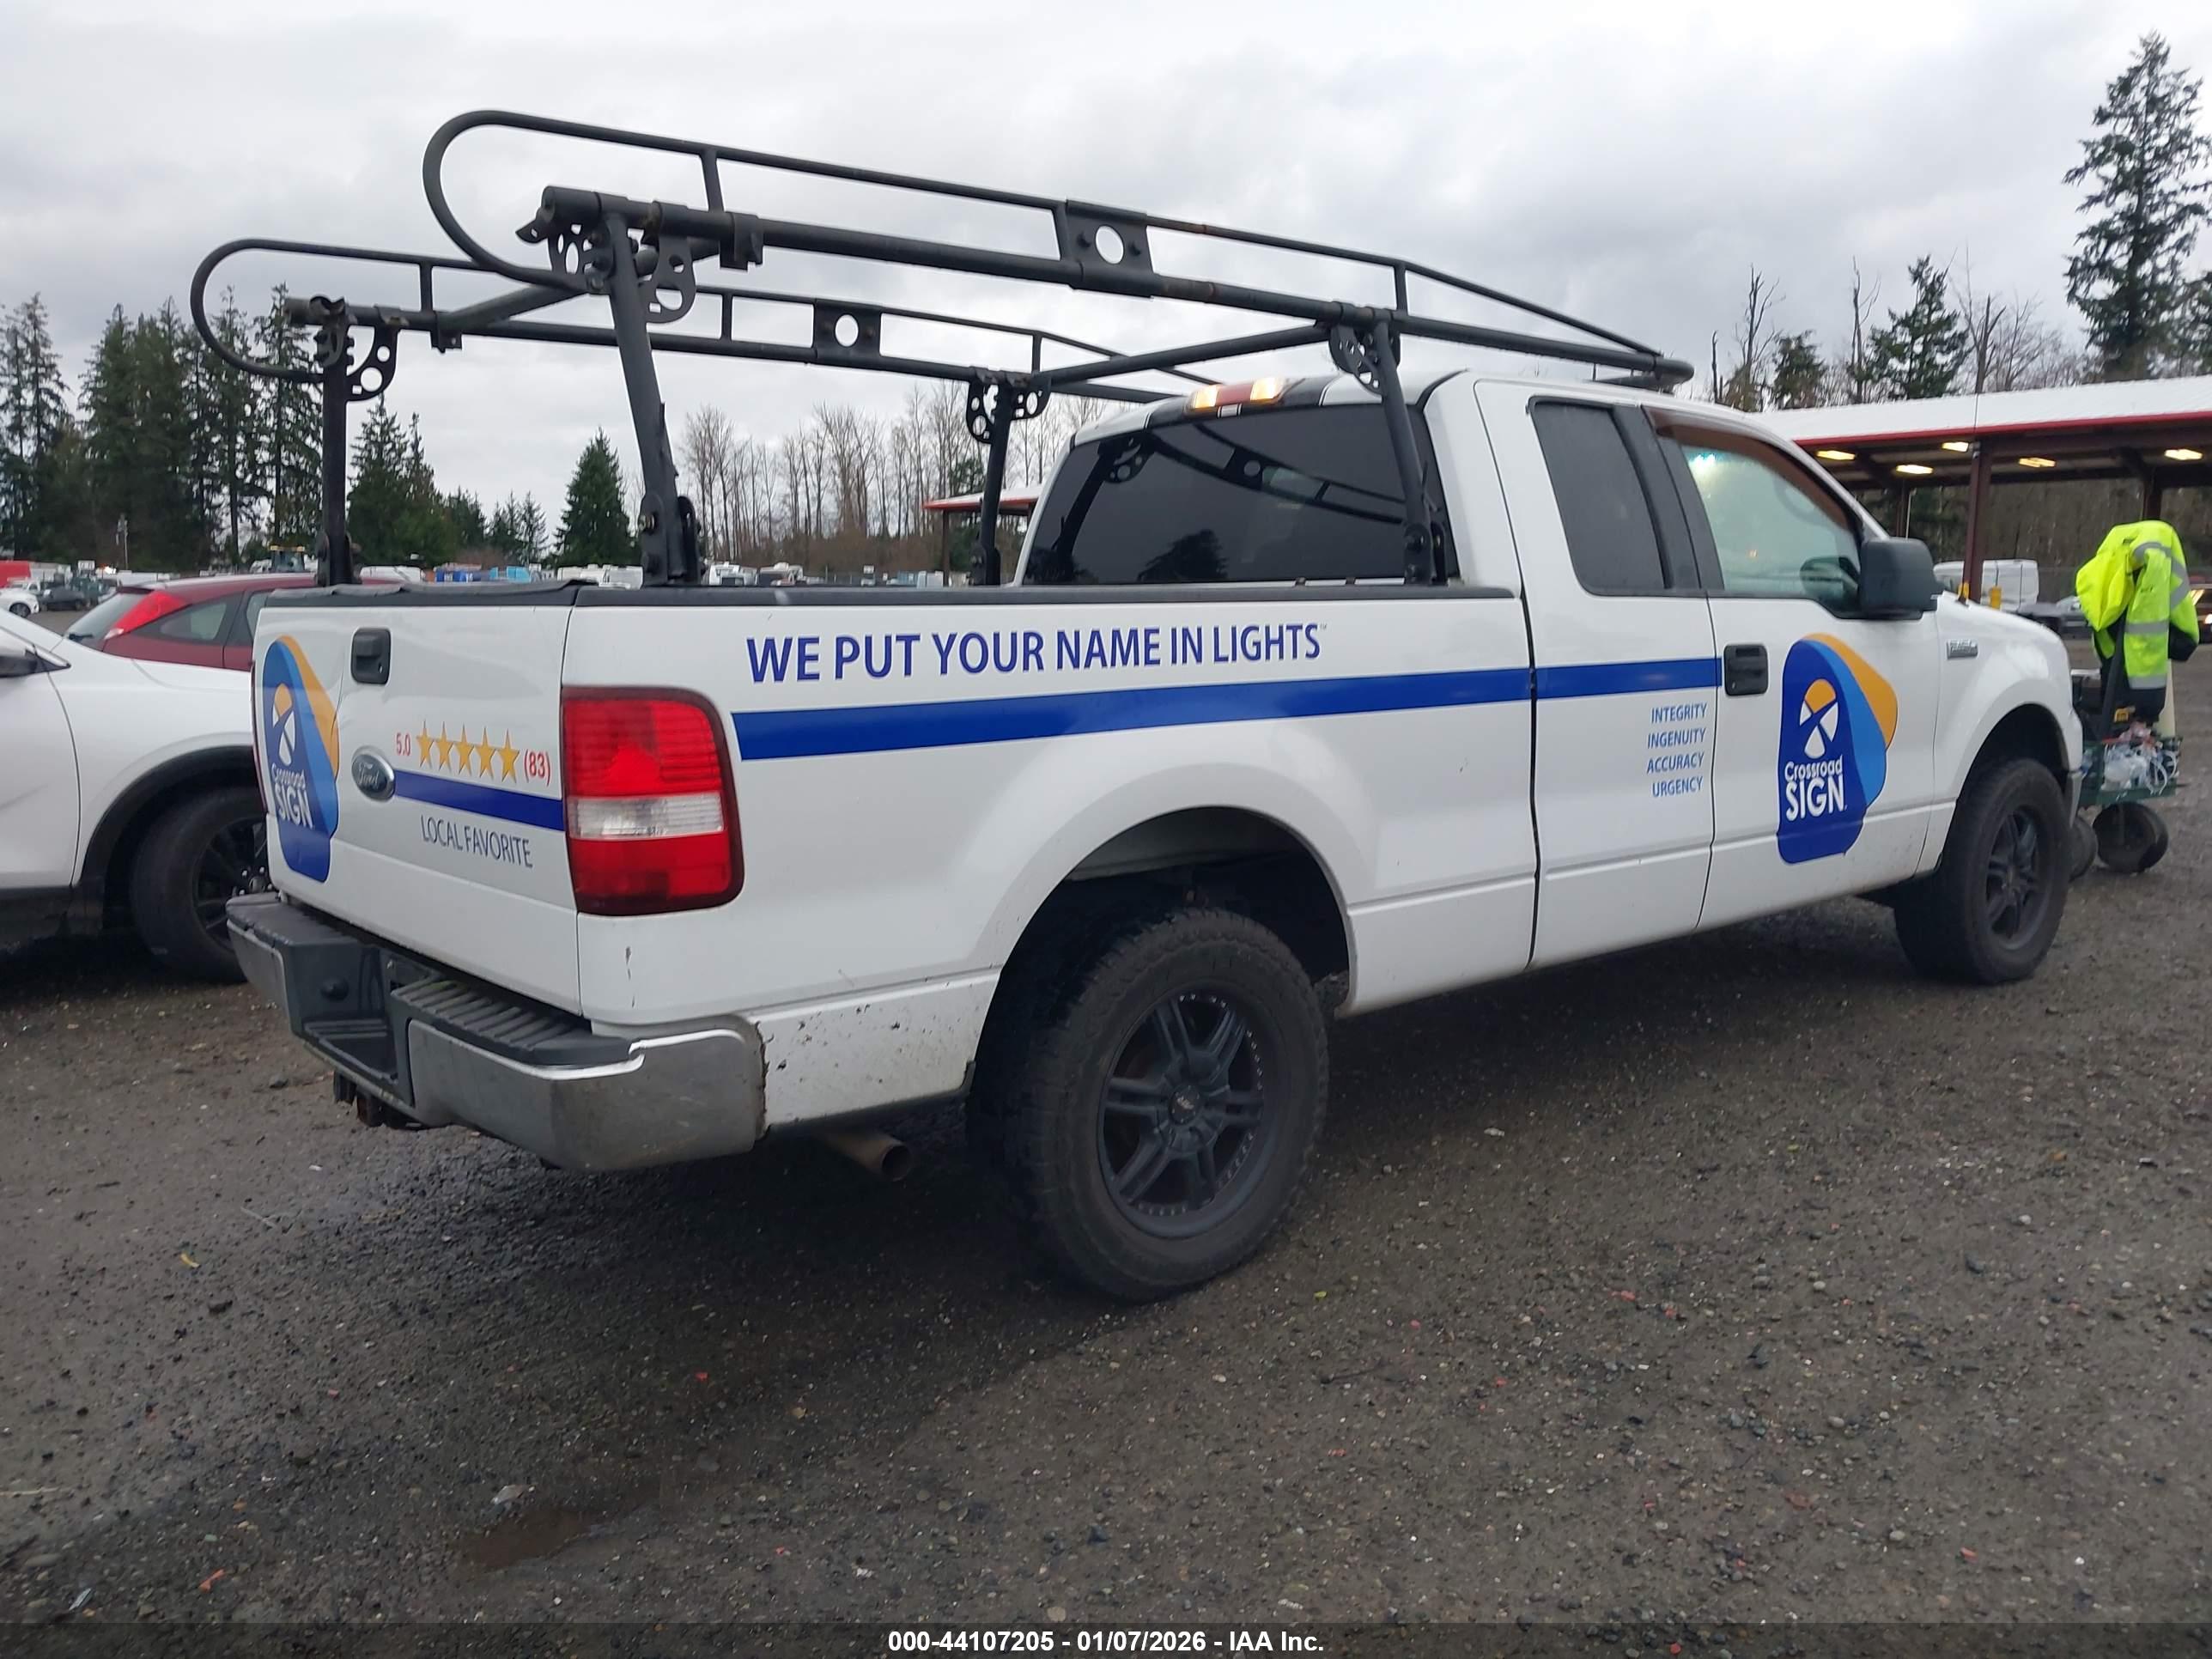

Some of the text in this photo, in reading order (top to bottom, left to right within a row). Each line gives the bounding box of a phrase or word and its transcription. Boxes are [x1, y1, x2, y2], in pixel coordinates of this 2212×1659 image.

[745, 635, 821, 684] WE
[835, 632, 921, 680] PUT
[933, 631, 1046, 675] YOUR
[1056, 627, 1161, 671] NAME
[1170, 625, 1204, 666] IN
[1650, 702, 1707, 723] INTEGRITY
[1647, 727, 1706, 749] INGENUITY
[395, 732, 551, 787] 5.0 (83)
[1647, 751, 1705, 774] ACCURACY
[1784, 753, 1843, 782] Crossroad
[1652, 775, 1704, 798] URGENCY
[274, 782, 313, 830] SIGN
[420, 813, 533, 868] LOCAL FAVORITE
